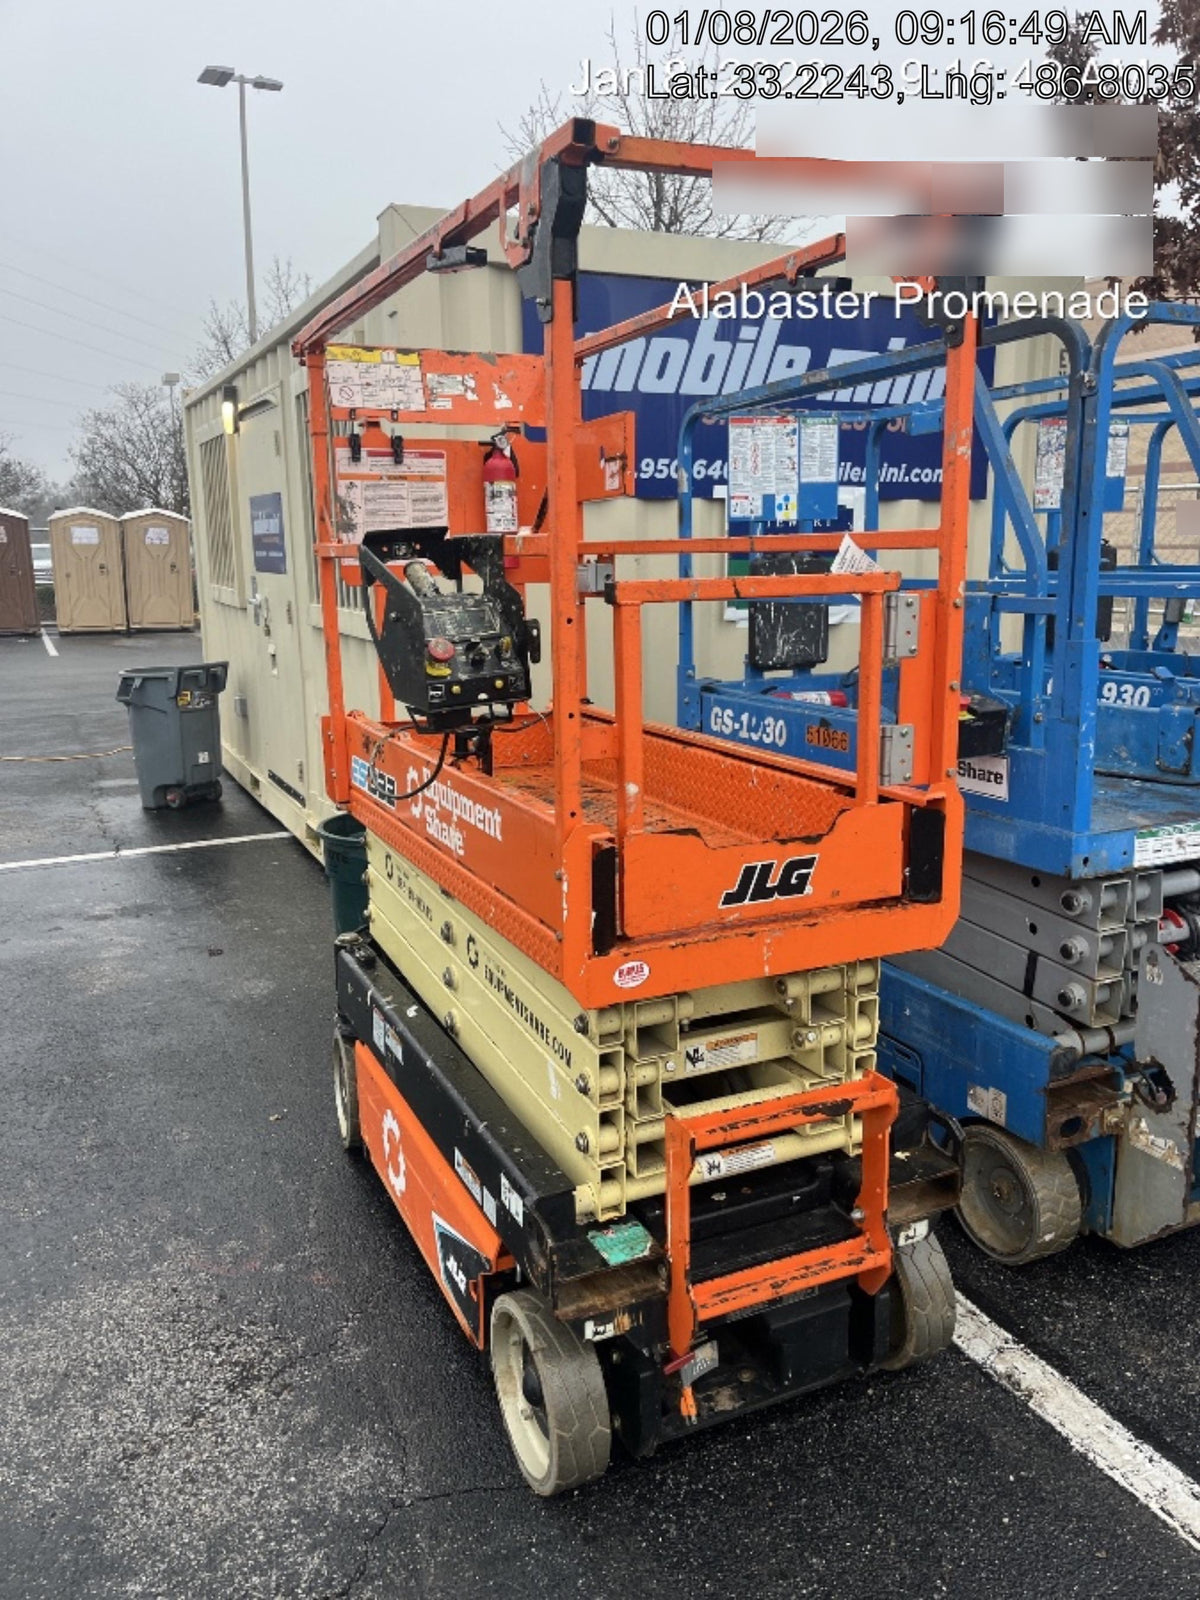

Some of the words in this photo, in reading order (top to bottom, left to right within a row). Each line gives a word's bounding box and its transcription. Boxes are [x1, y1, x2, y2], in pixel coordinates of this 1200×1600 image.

[581, 316, 811, 396] mobile
[423, 766, 502, 841] Equipment
[425, 805, 465, 855] Share
[719, 853, 818, 908] JLG
